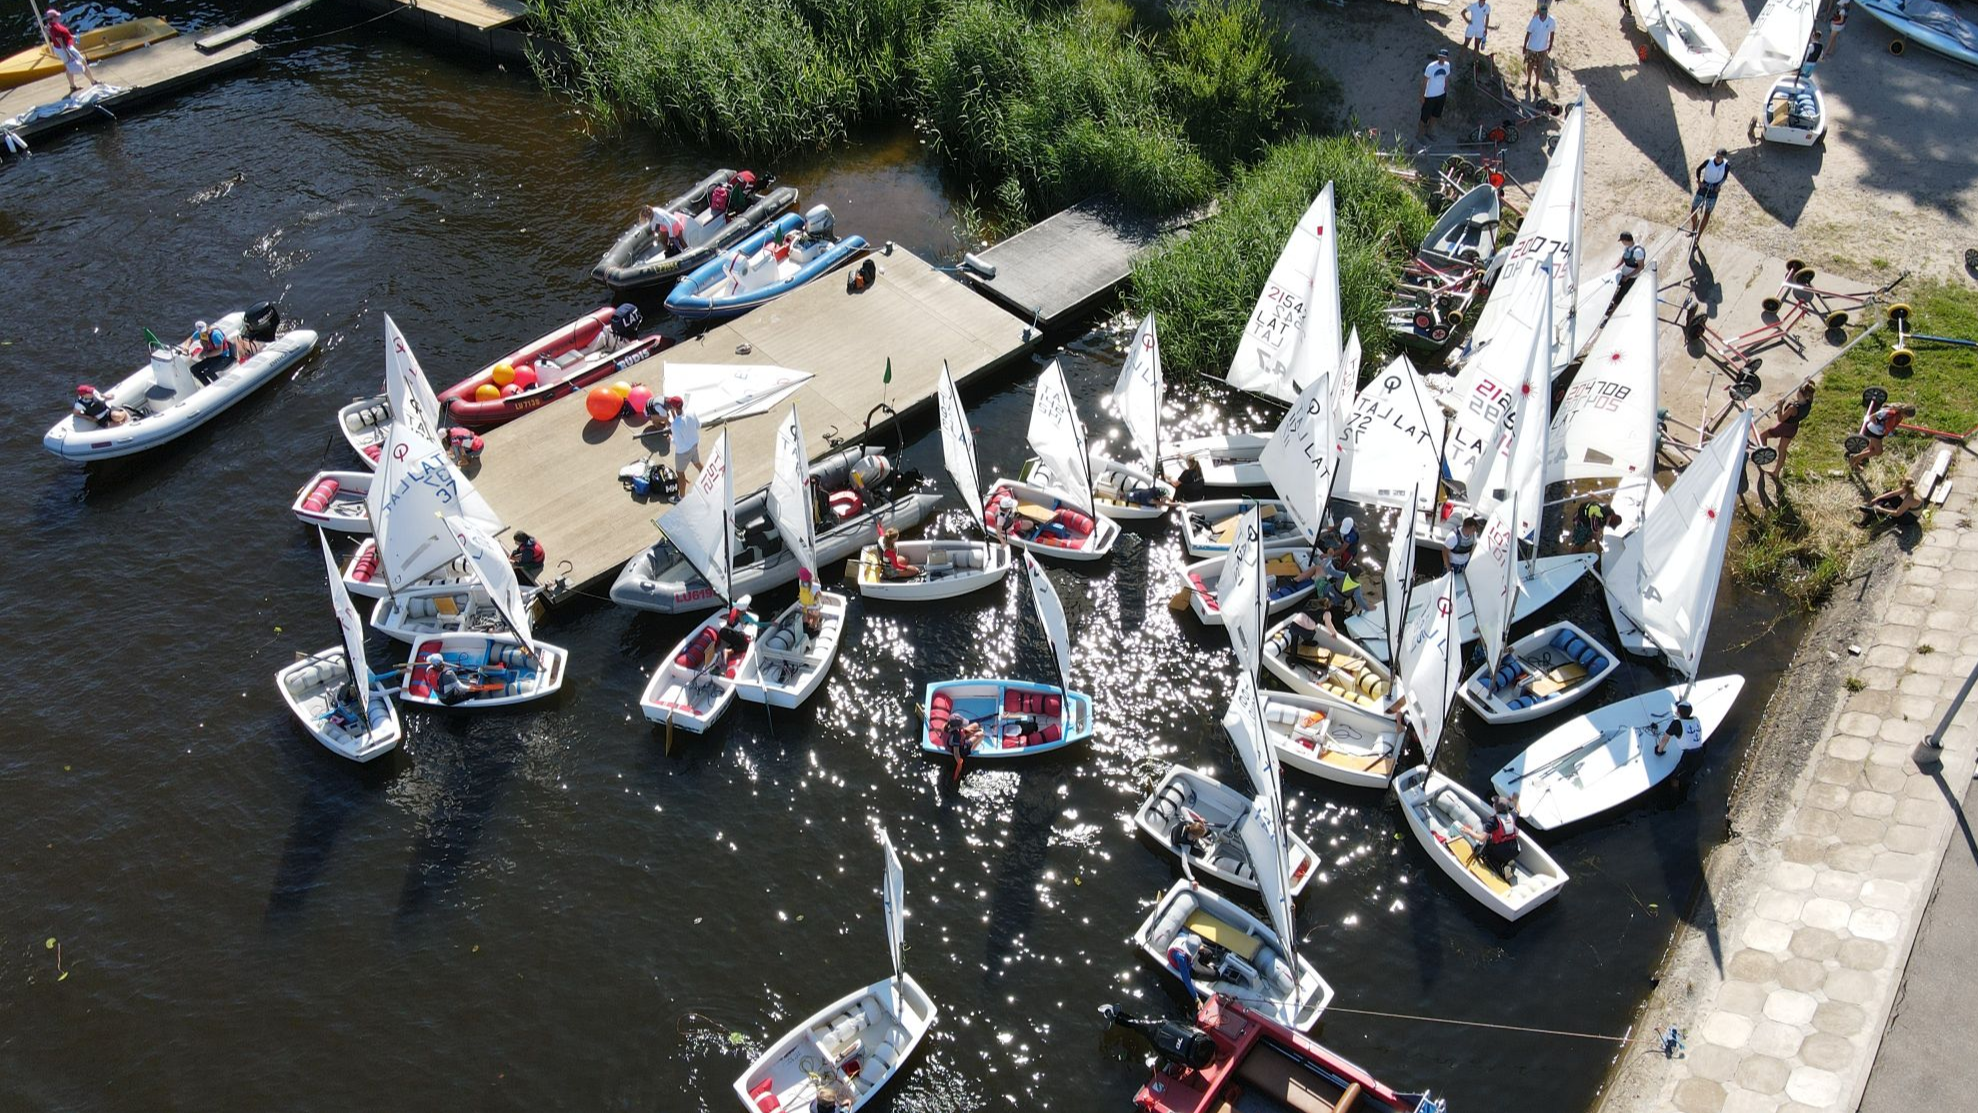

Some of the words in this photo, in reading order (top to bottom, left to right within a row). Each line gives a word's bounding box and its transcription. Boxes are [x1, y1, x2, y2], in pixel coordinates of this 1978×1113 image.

[622, 308, 640, 328] LAT
[1256, 310, 1290, 334] LAT
[1567, 381, 1632, 400] 204708
[1393, 414, 1430, 445] LAT
[407, 452, 445, 482] LAT
[1304, 442, 1331, 479] LAT
